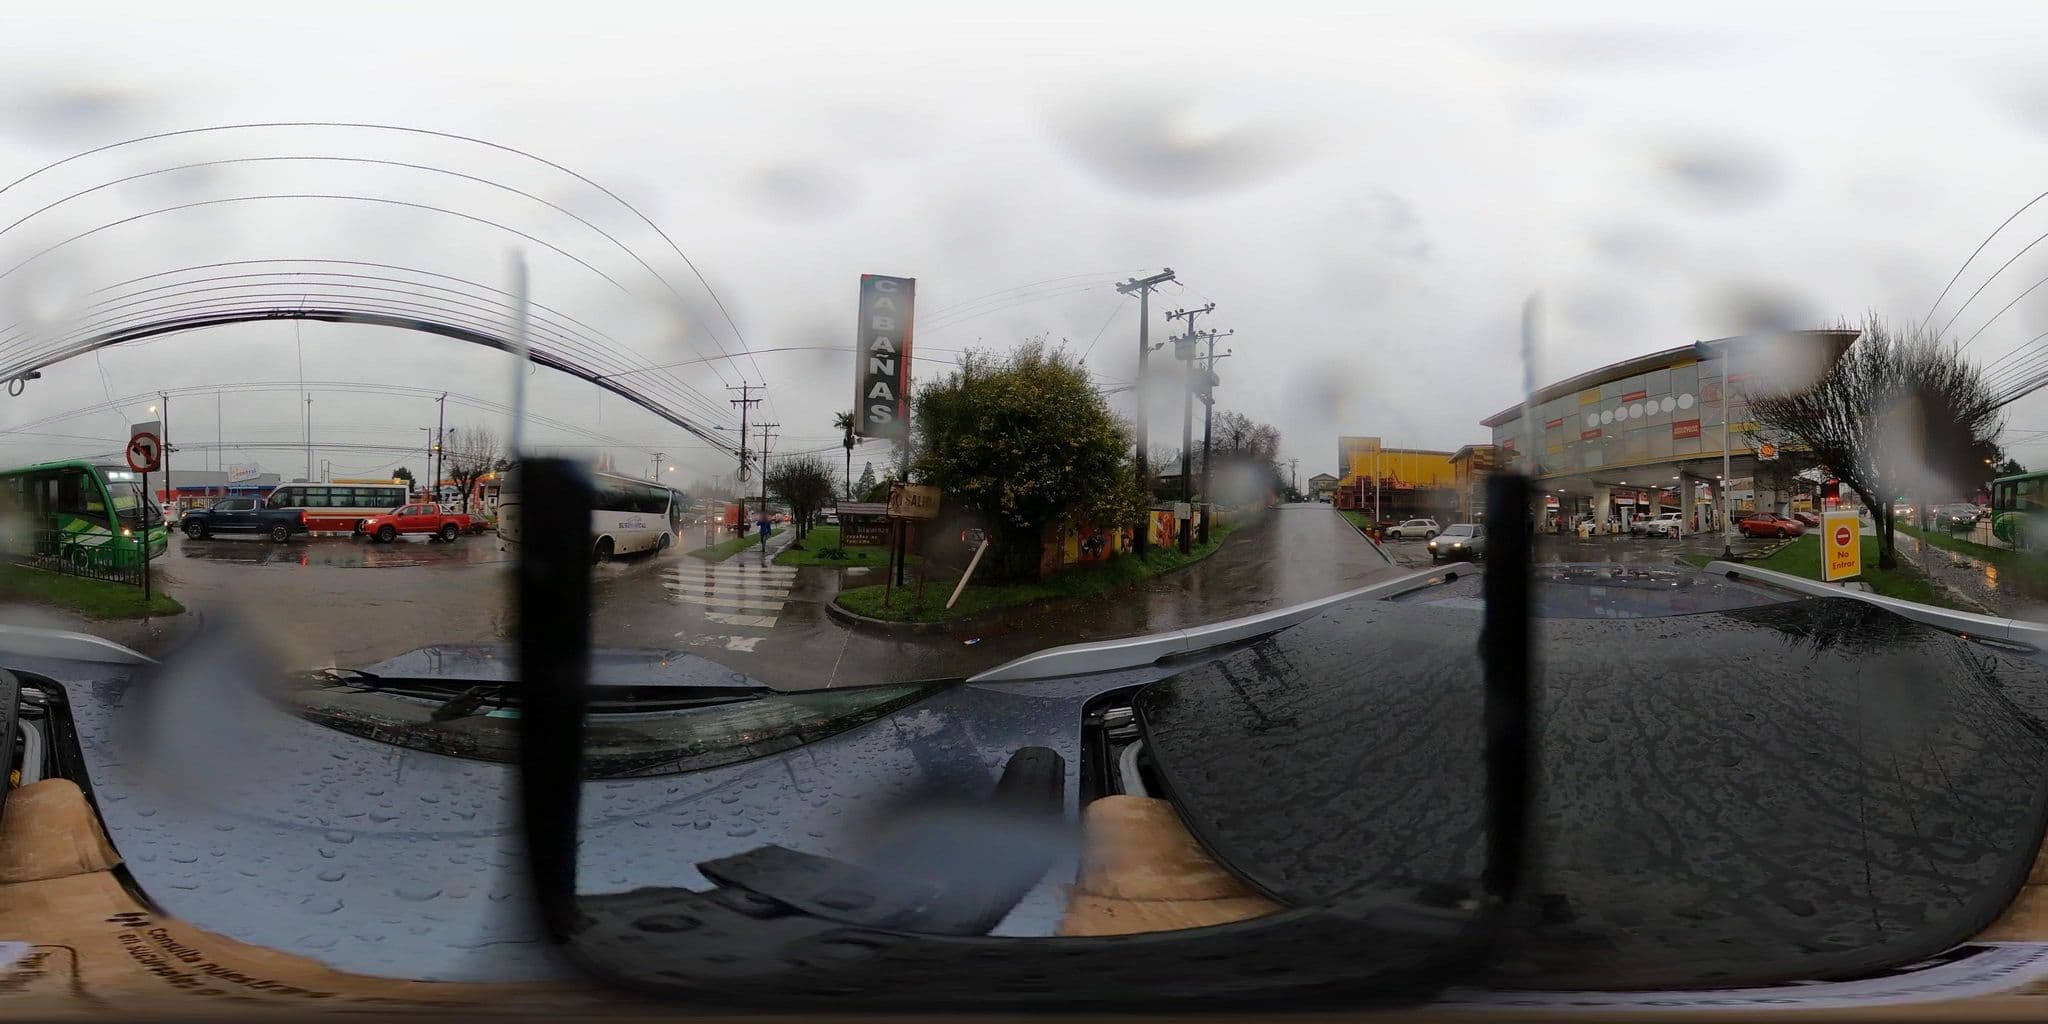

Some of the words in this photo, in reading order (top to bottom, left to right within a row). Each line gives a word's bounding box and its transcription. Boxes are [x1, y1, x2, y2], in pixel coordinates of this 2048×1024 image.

[868, 280, 895, 424] CABAÑAS
[904, 494, 936, 507] SALI
[1837, 551, 1849, 559] No
[1832, 560, 1855, 570] Entrar
[149, 928, 202, 963] Consulta
